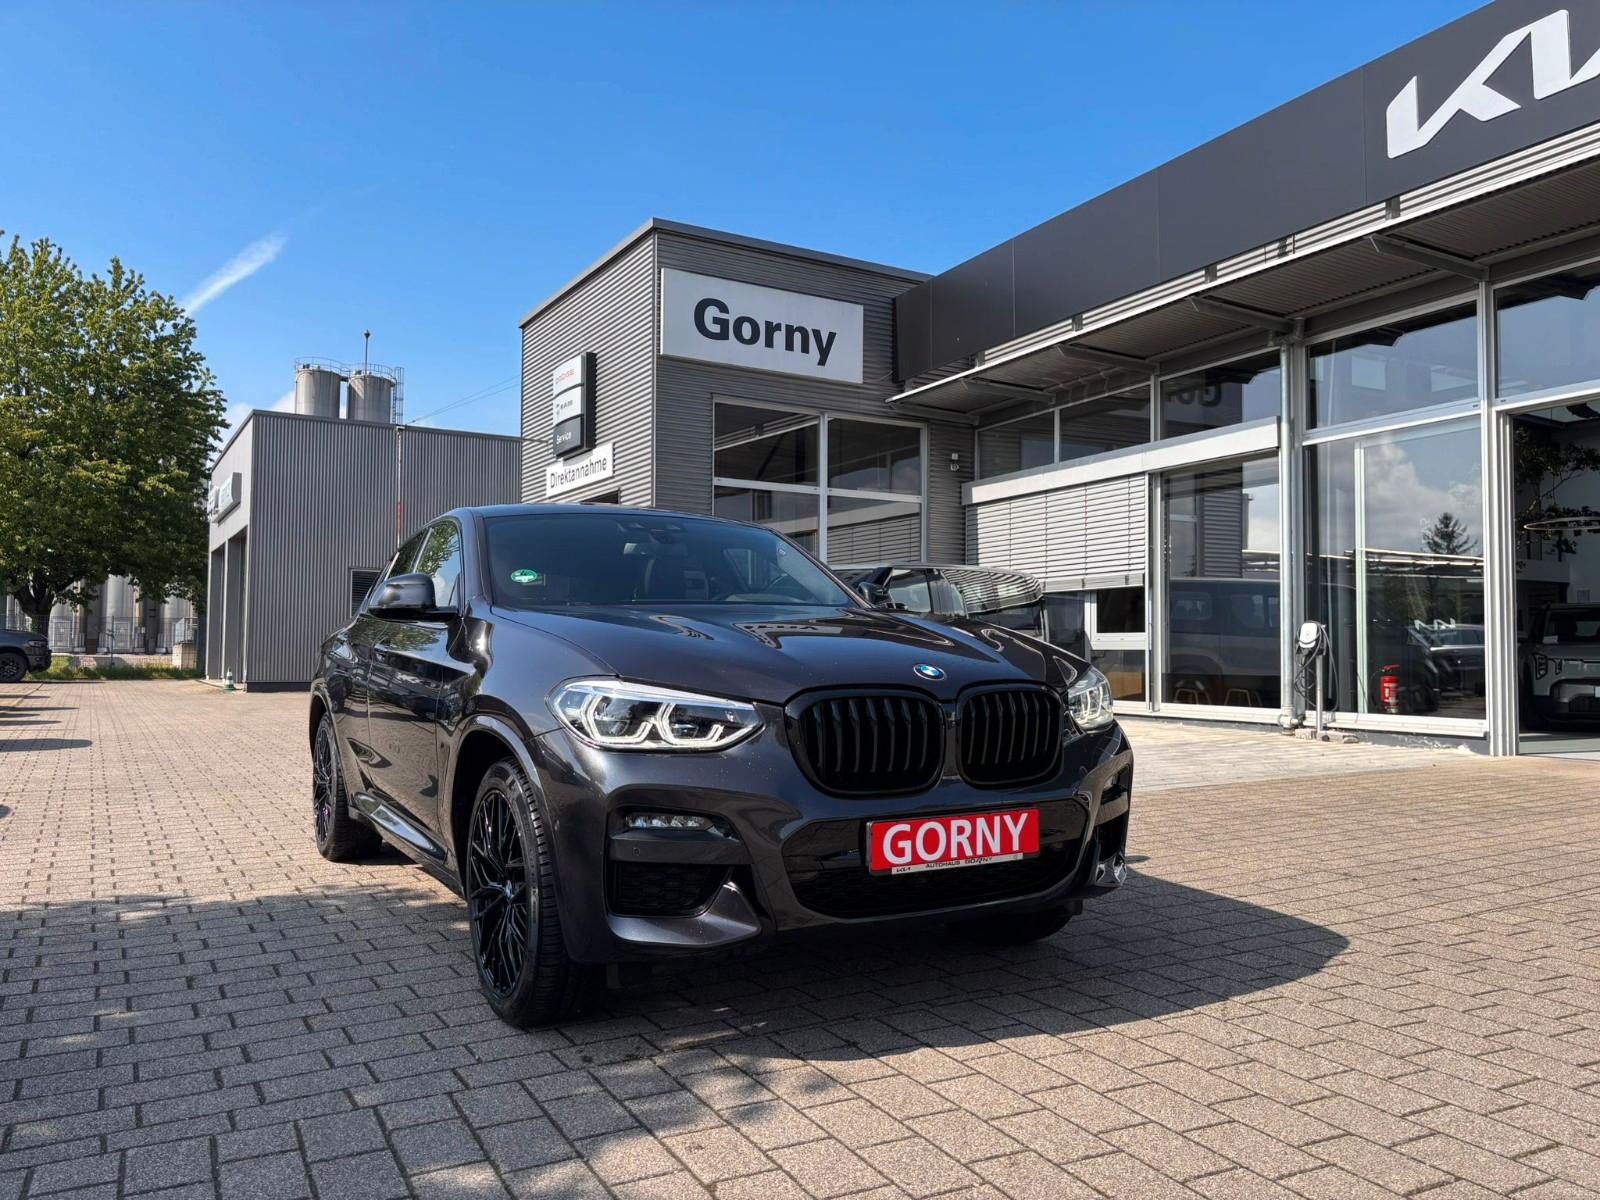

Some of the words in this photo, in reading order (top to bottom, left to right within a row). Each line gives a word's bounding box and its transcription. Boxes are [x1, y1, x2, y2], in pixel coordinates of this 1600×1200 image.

[1386, 9, 1600, 159] KI
[693, 297, 837, 367] Gorny
[556, 431, 572, 445] Service
[550, 457, 607, 489] Direktannahme
[882, 813, 1029, 865] GORNY
[925, 860, 960, 869] AUTOHAUS
